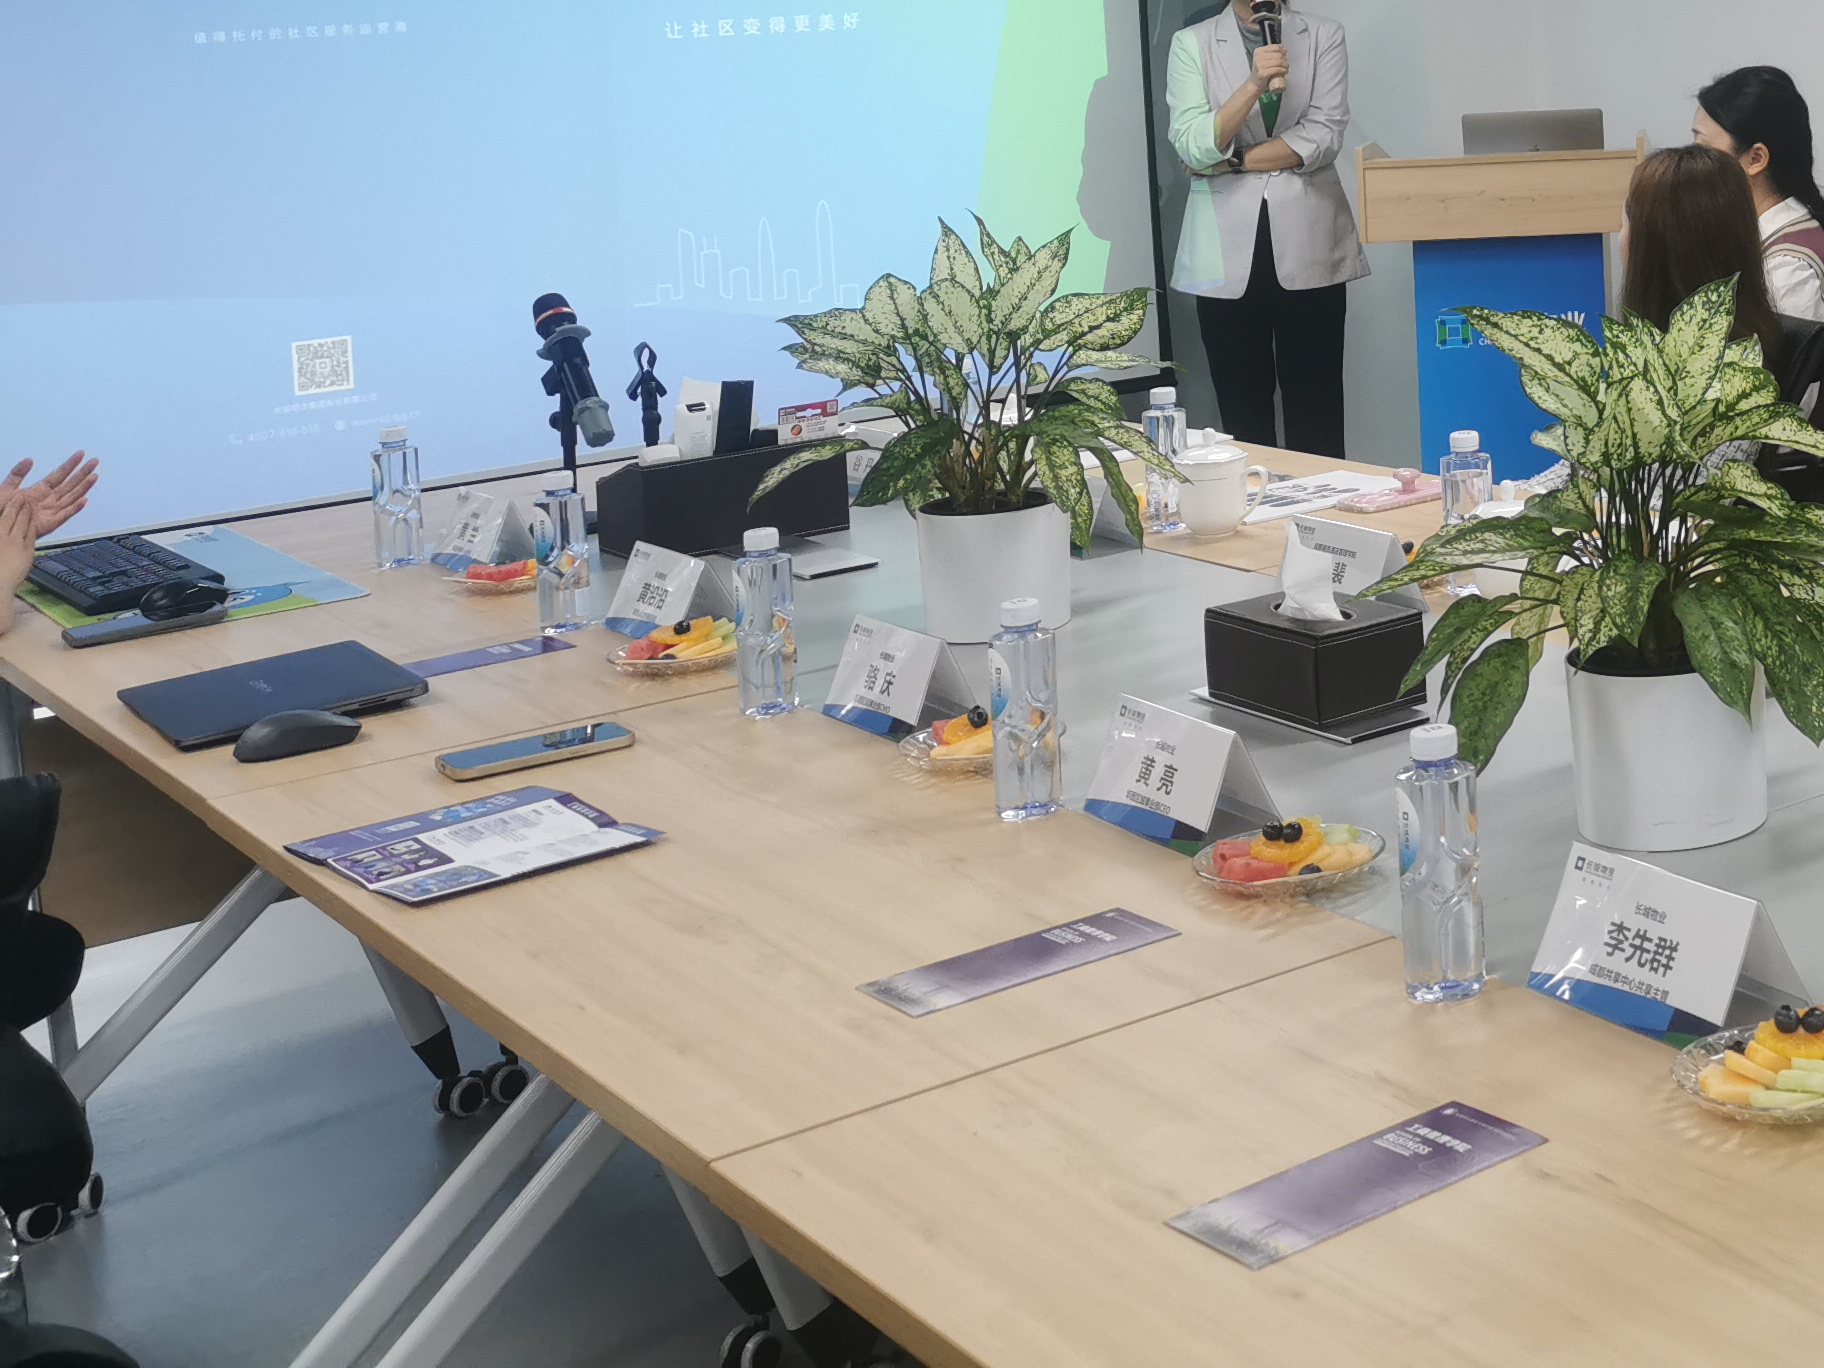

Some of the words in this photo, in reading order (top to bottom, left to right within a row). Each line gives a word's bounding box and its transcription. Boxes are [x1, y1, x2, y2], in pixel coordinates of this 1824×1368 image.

[664, 12, 860, 39] 让社区变得更美好
[1135, 755, 1178, 796] 黄亮
[1603, 920, 1681, 978] 李先群
